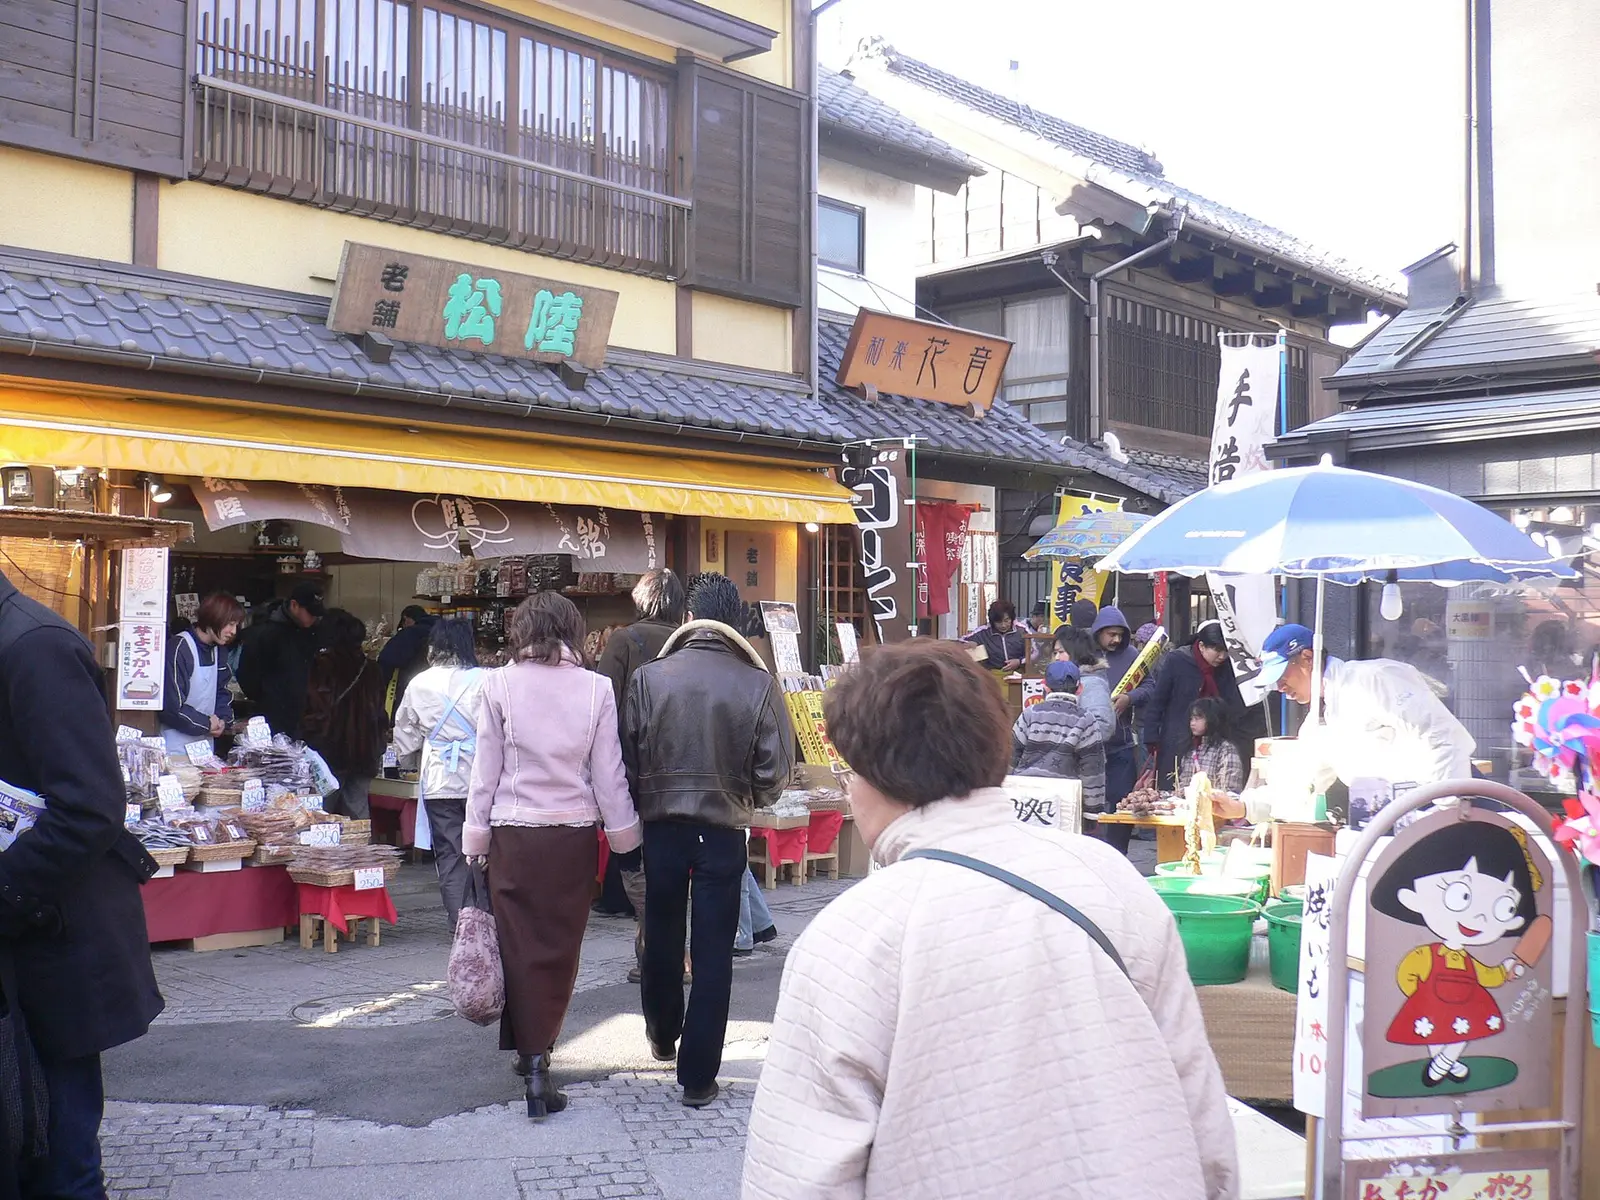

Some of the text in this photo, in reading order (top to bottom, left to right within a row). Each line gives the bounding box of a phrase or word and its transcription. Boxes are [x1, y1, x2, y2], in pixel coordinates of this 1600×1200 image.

[371, 262, 409, 329] 老舗
[442, 272, 584, 358] 松陸
[865, 336, 992, 395] 和楽 花音
[132, 625, 153, 679] 芋ようかん
[159, 787, 181, 800] 350
[245, 793, 265, 804] 350
[317, 830, 339, 845] 250
[360, 878, 379, 889] 250
[1305, 882, 1327, 999] 焼いも
[1299, 1051, 1328, 1075] 10
